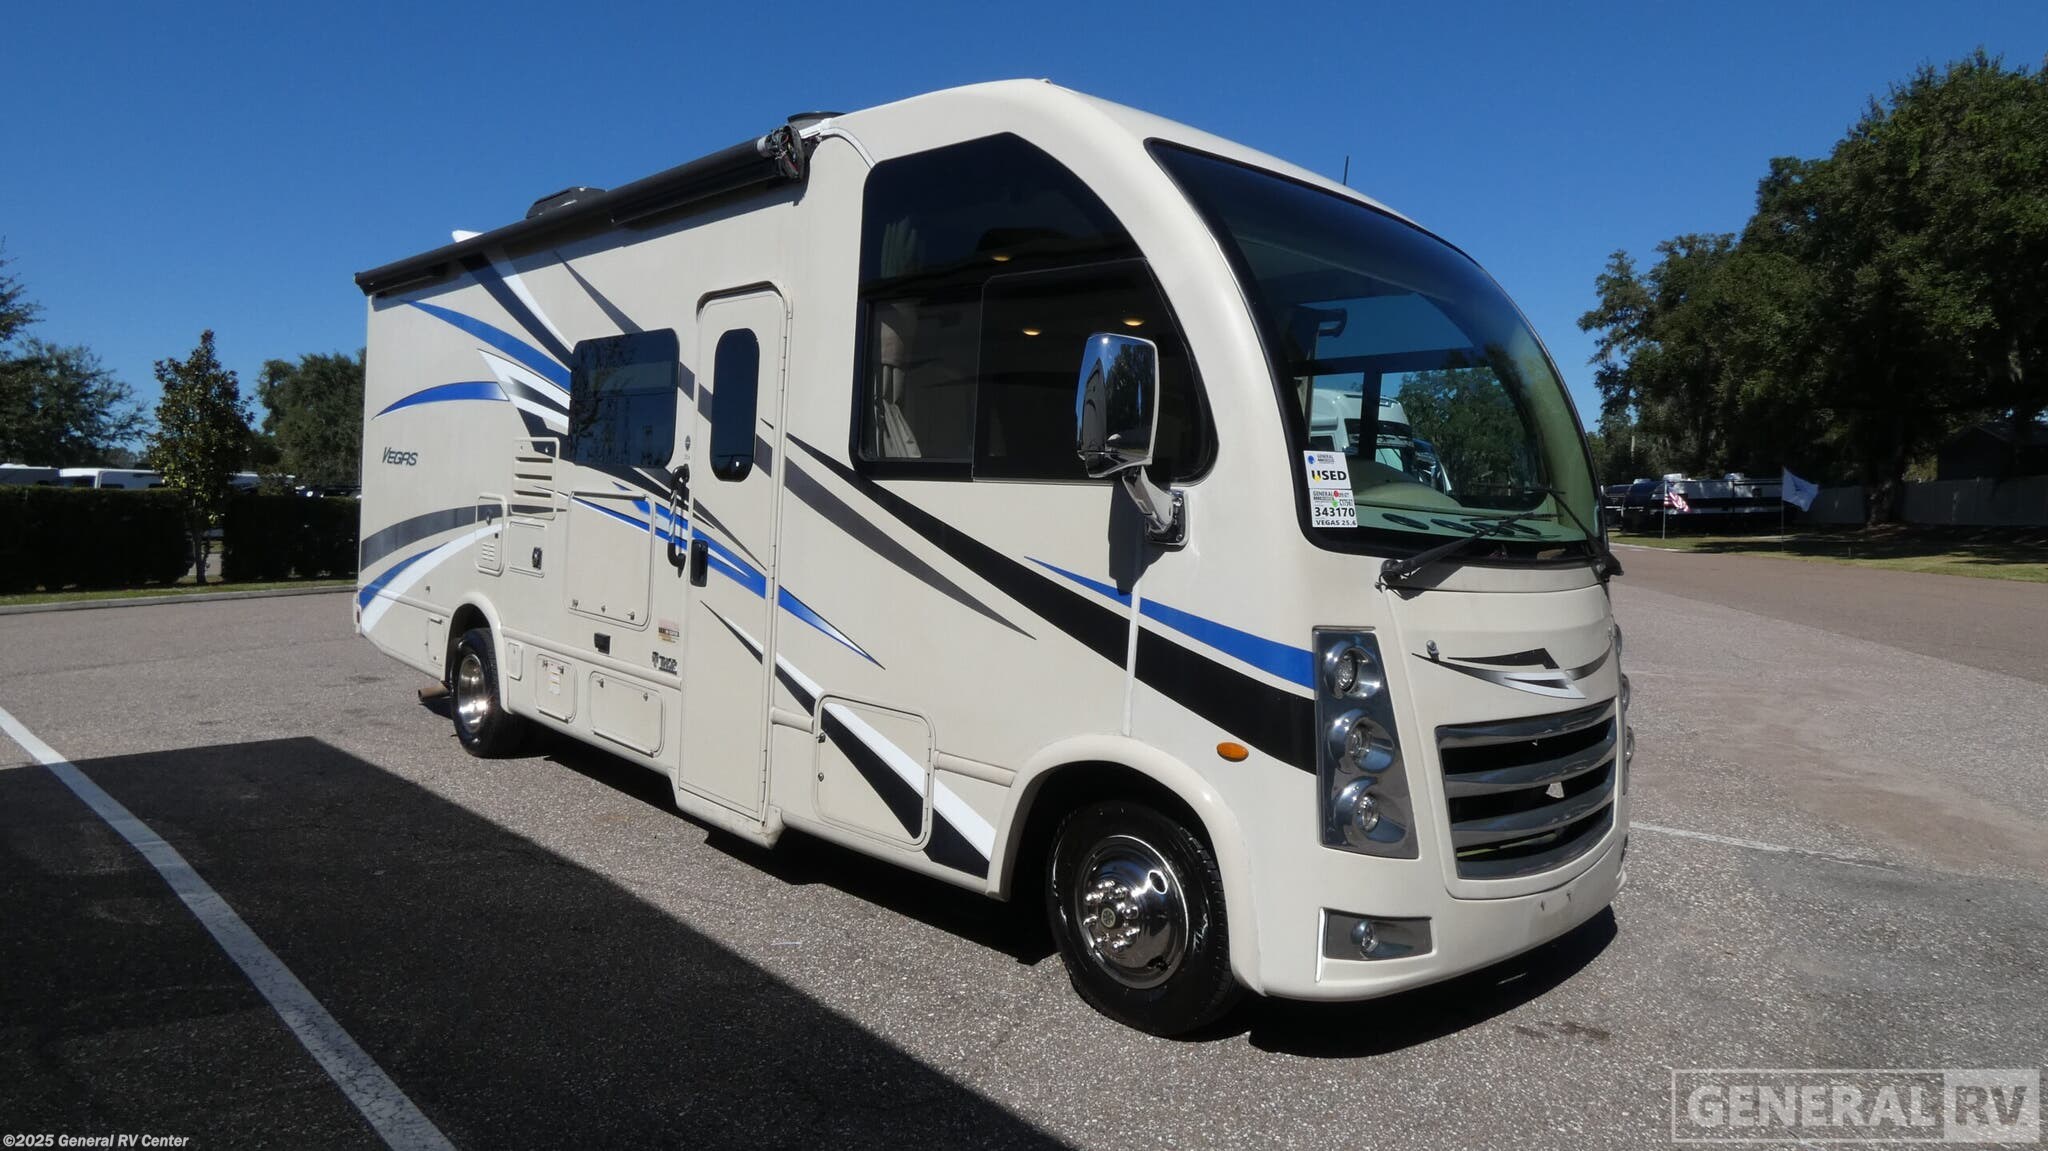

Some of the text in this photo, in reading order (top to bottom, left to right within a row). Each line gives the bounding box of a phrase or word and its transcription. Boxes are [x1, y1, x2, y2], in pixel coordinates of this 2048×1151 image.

[382, 446, 418, 466] VEGAS
[1311, 469, 1347, 481] USED
[1314, 507, 1355, 517] 343170
